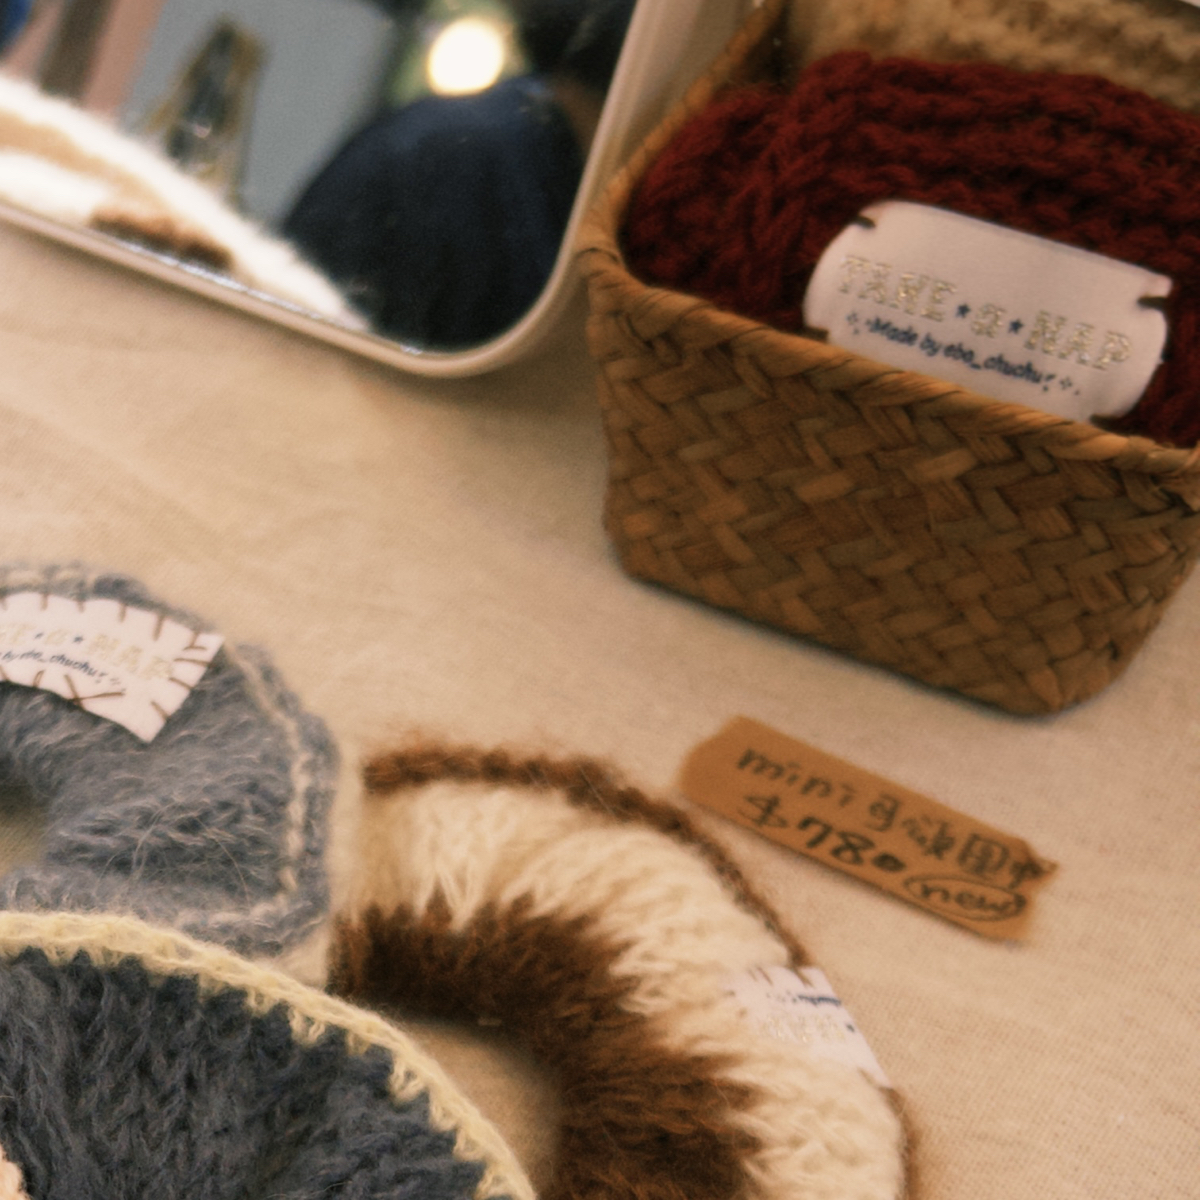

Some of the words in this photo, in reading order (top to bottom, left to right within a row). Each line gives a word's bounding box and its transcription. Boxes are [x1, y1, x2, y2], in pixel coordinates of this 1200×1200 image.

[838, 255, 957, 323] TAKE
[1024, 309, 1133, 370] NAP
[872, 314, 918, 347] Made
[919, 332, 943, 358] by
[736, 748, 857, 807] mini
[736, 793, 906, 873] $780
